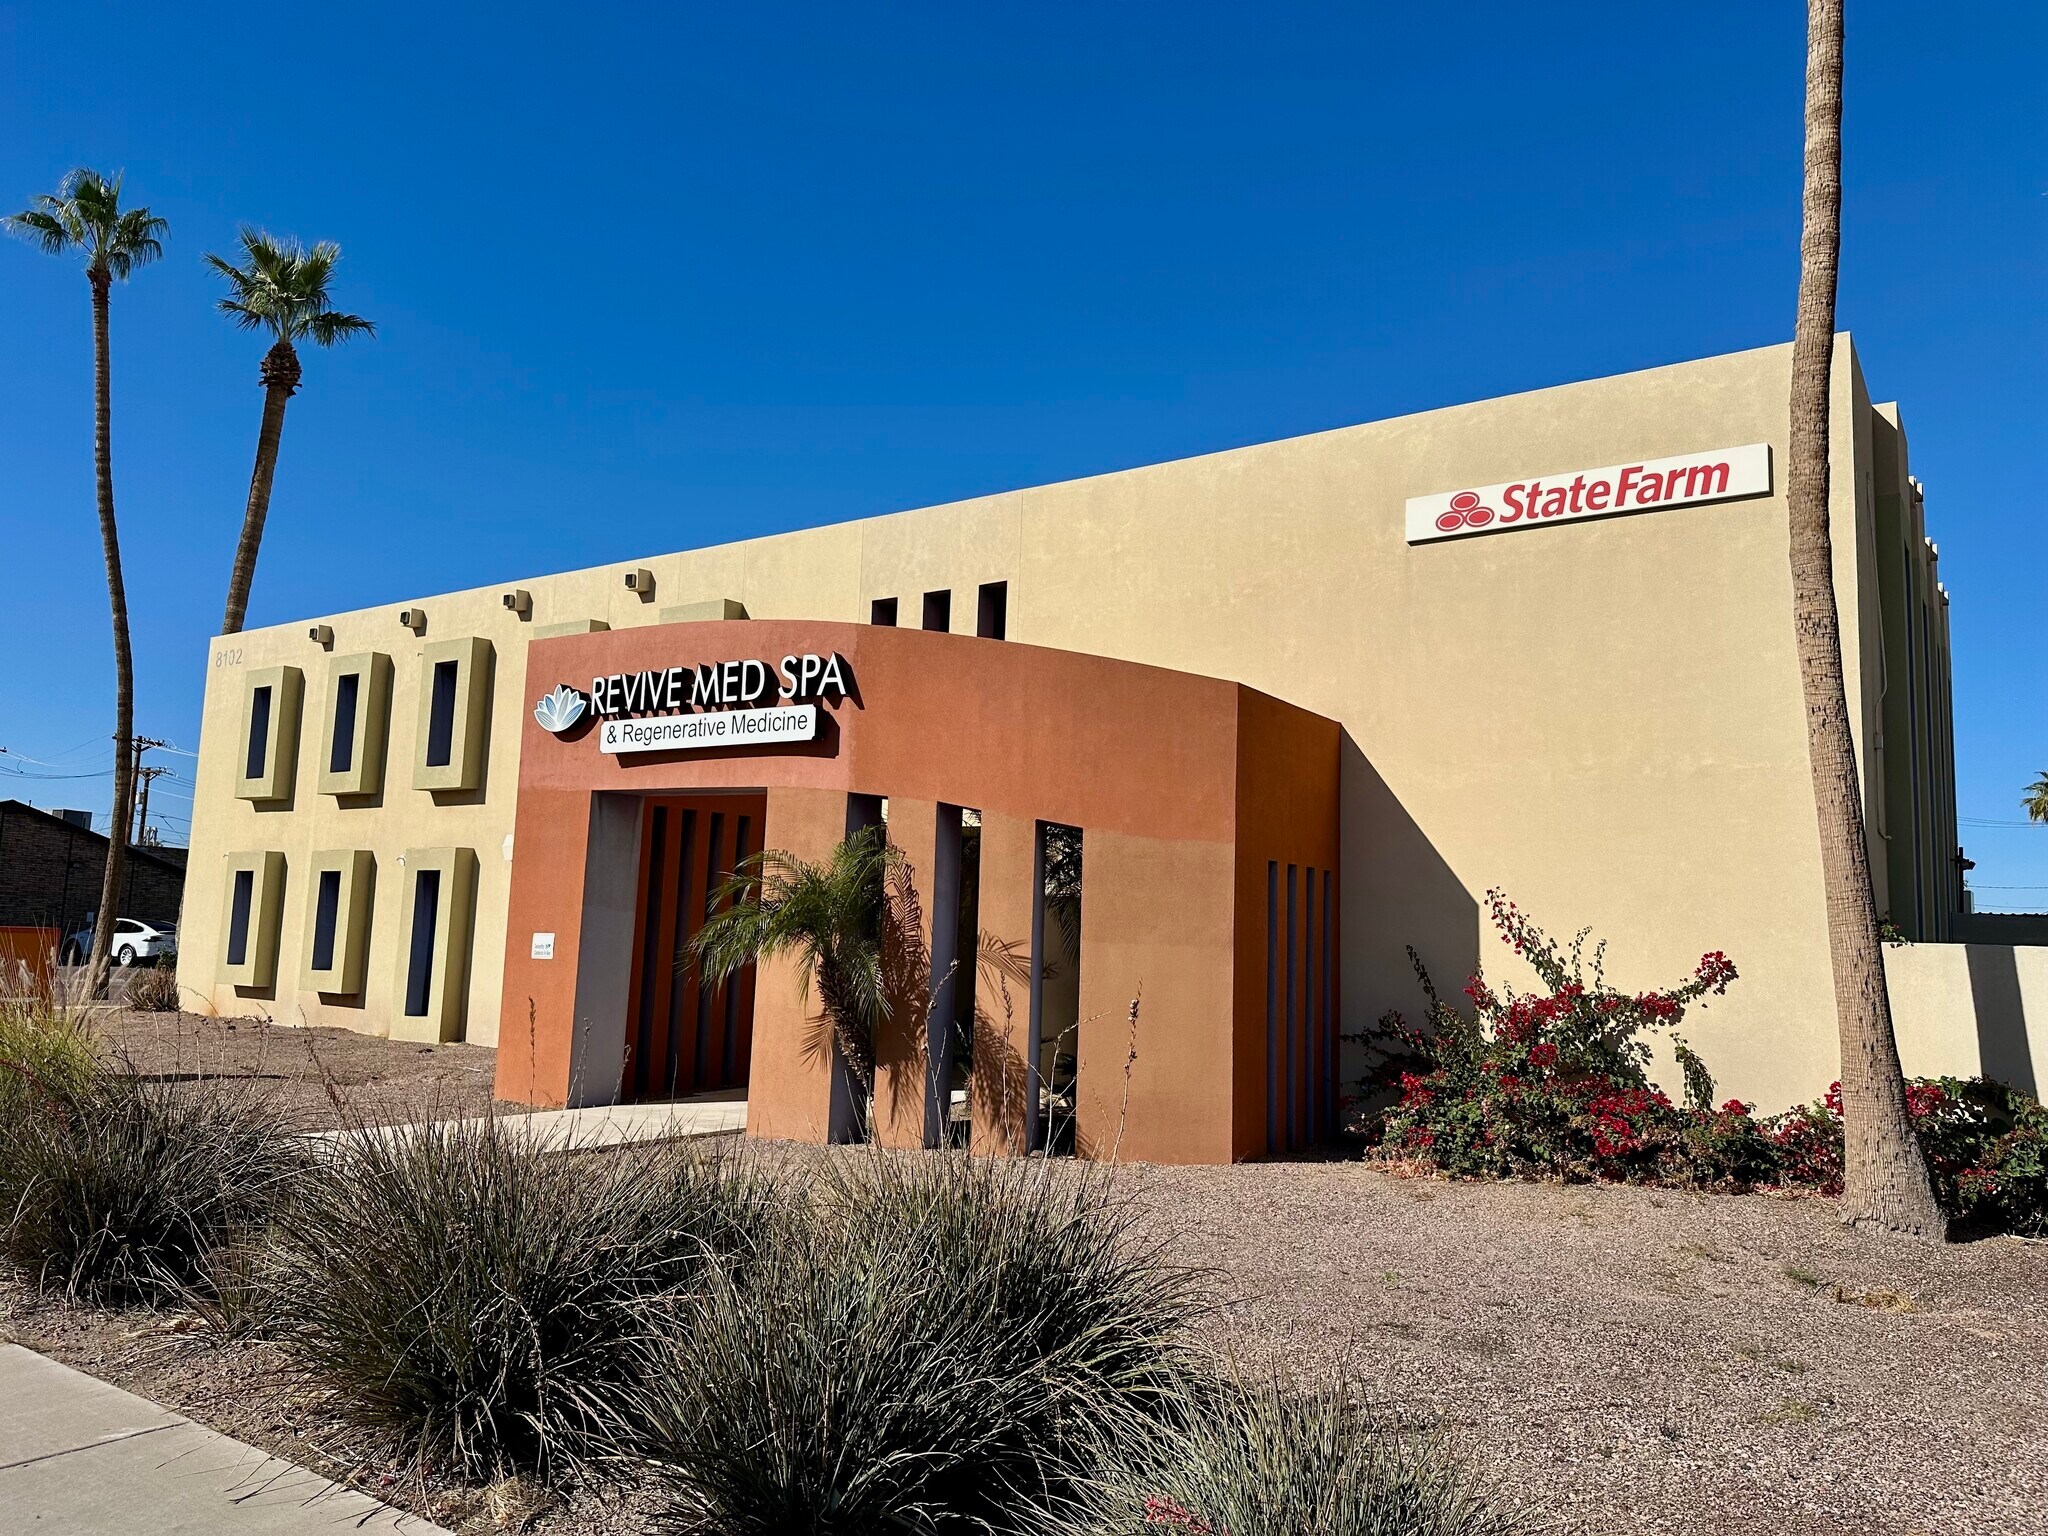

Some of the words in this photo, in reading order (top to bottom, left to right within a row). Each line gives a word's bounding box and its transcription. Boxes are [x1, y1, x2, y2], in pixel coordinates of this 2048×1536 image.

[215, 647, 243, 668] 8102
[590, 666, 683, 716] REVIVE
[690, 658, 765, 706] MED
[777, 651, 847, 699] SPA
[606, 728, 618, 744] &
[622, 716, 726, 746] Regenerative
[731, 710, 808, 734] Medicine
